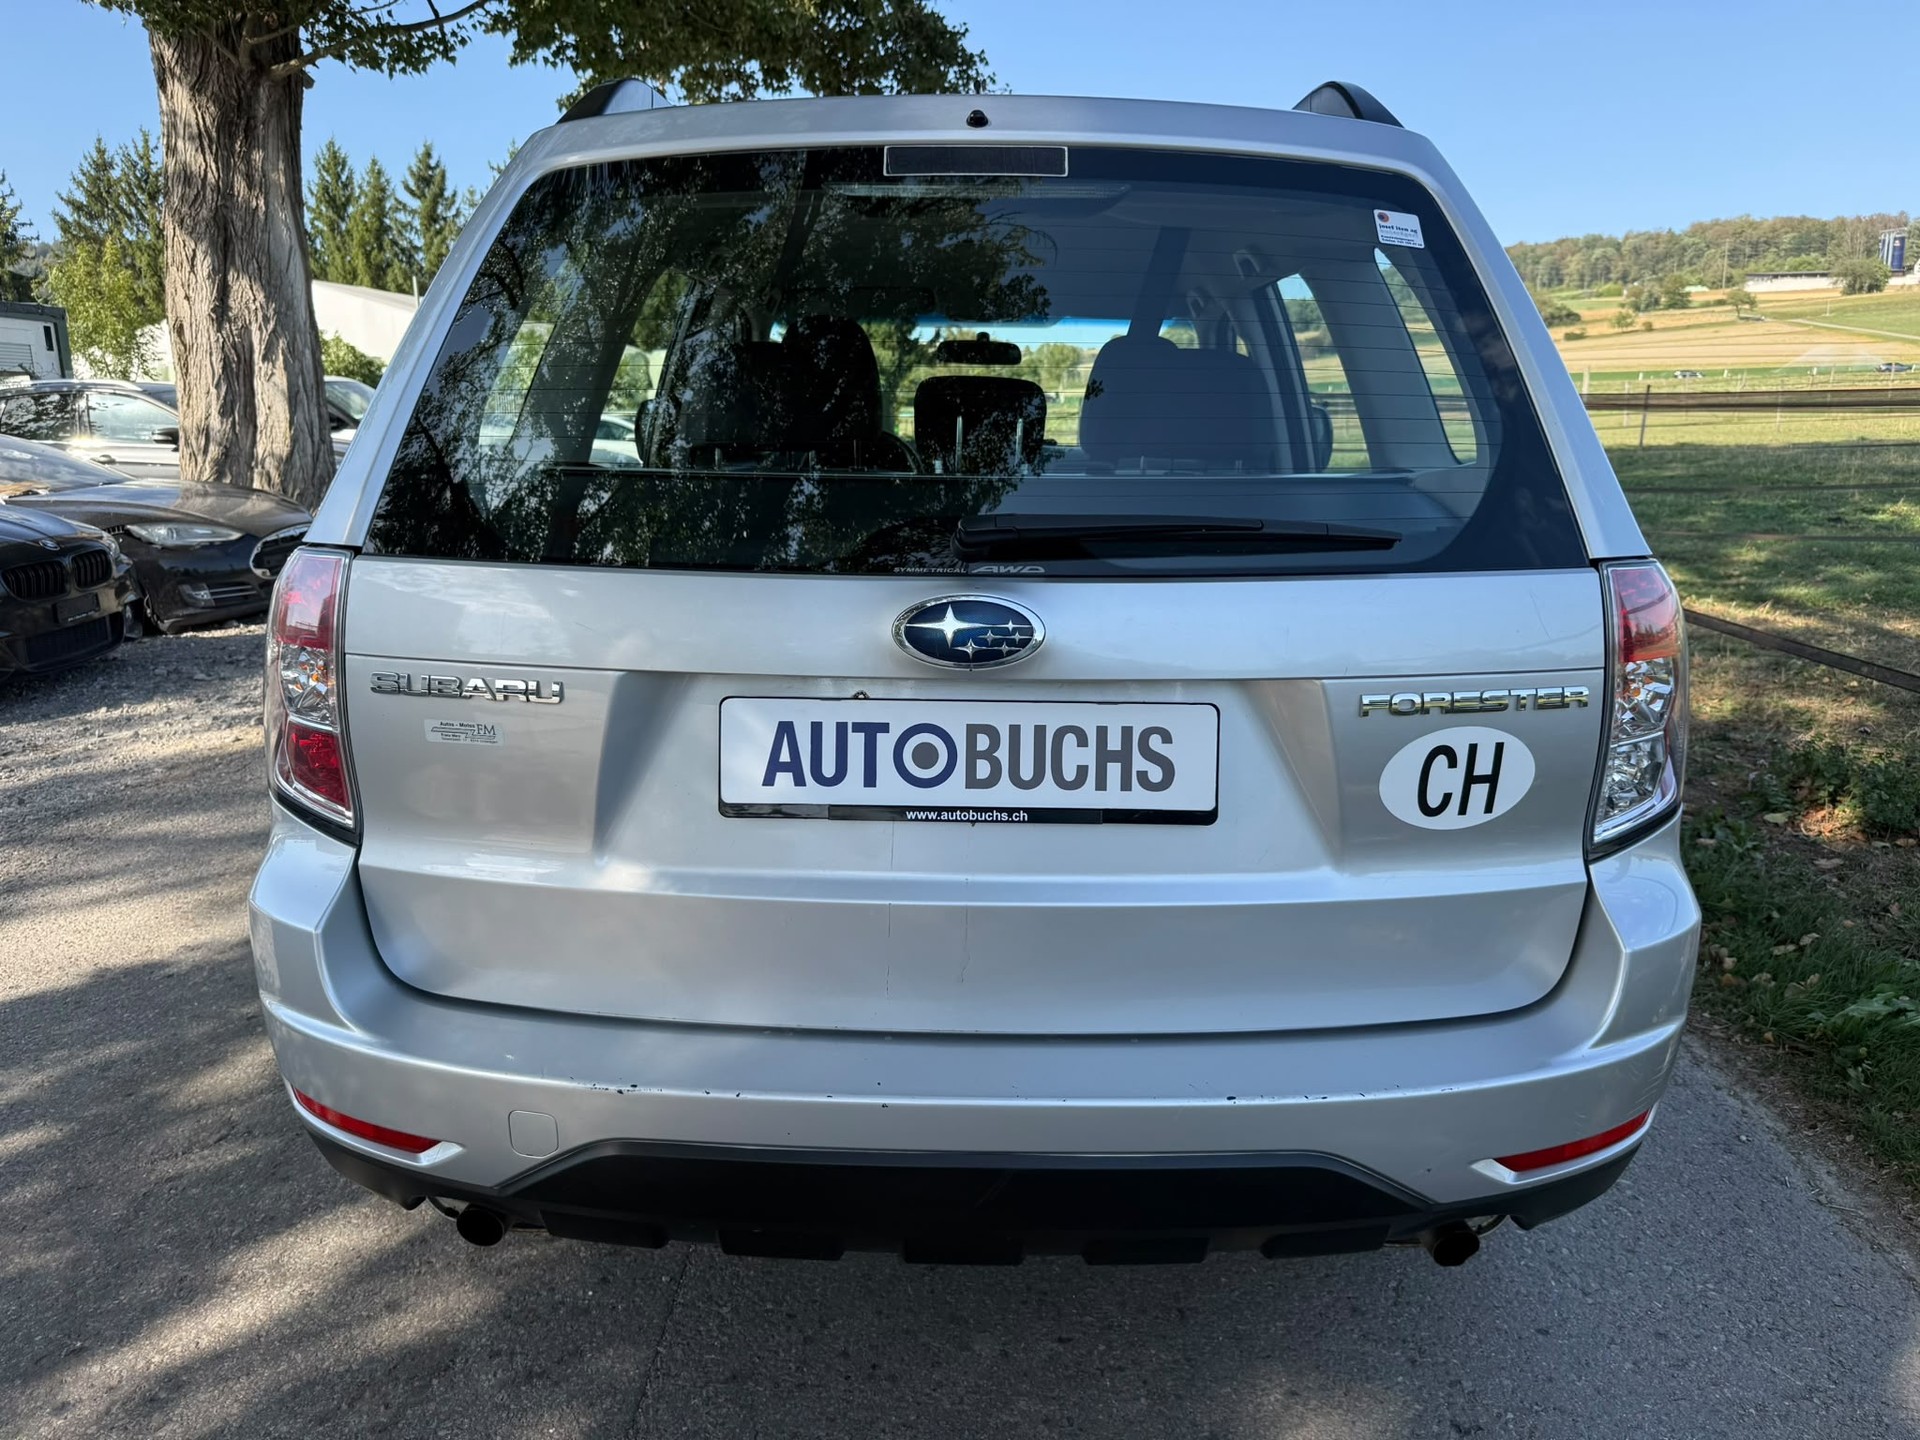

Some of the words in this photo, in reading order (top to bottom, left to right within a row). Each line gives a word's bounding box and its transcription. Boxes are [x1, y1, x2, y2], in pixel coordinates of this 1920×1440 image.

[893, 566, 967, 574] SYMMETRICAL
[971, 565, 1046, 574] AWD
[369, 670, 565, 705] SUBARU
[1358, 685, 1590, 718] FORESTER
[476, 723, 497, 736] FM
[1417, 741, 1505, 818] CH
[905, 809, 1029, 822] www.autobuchs.ch
